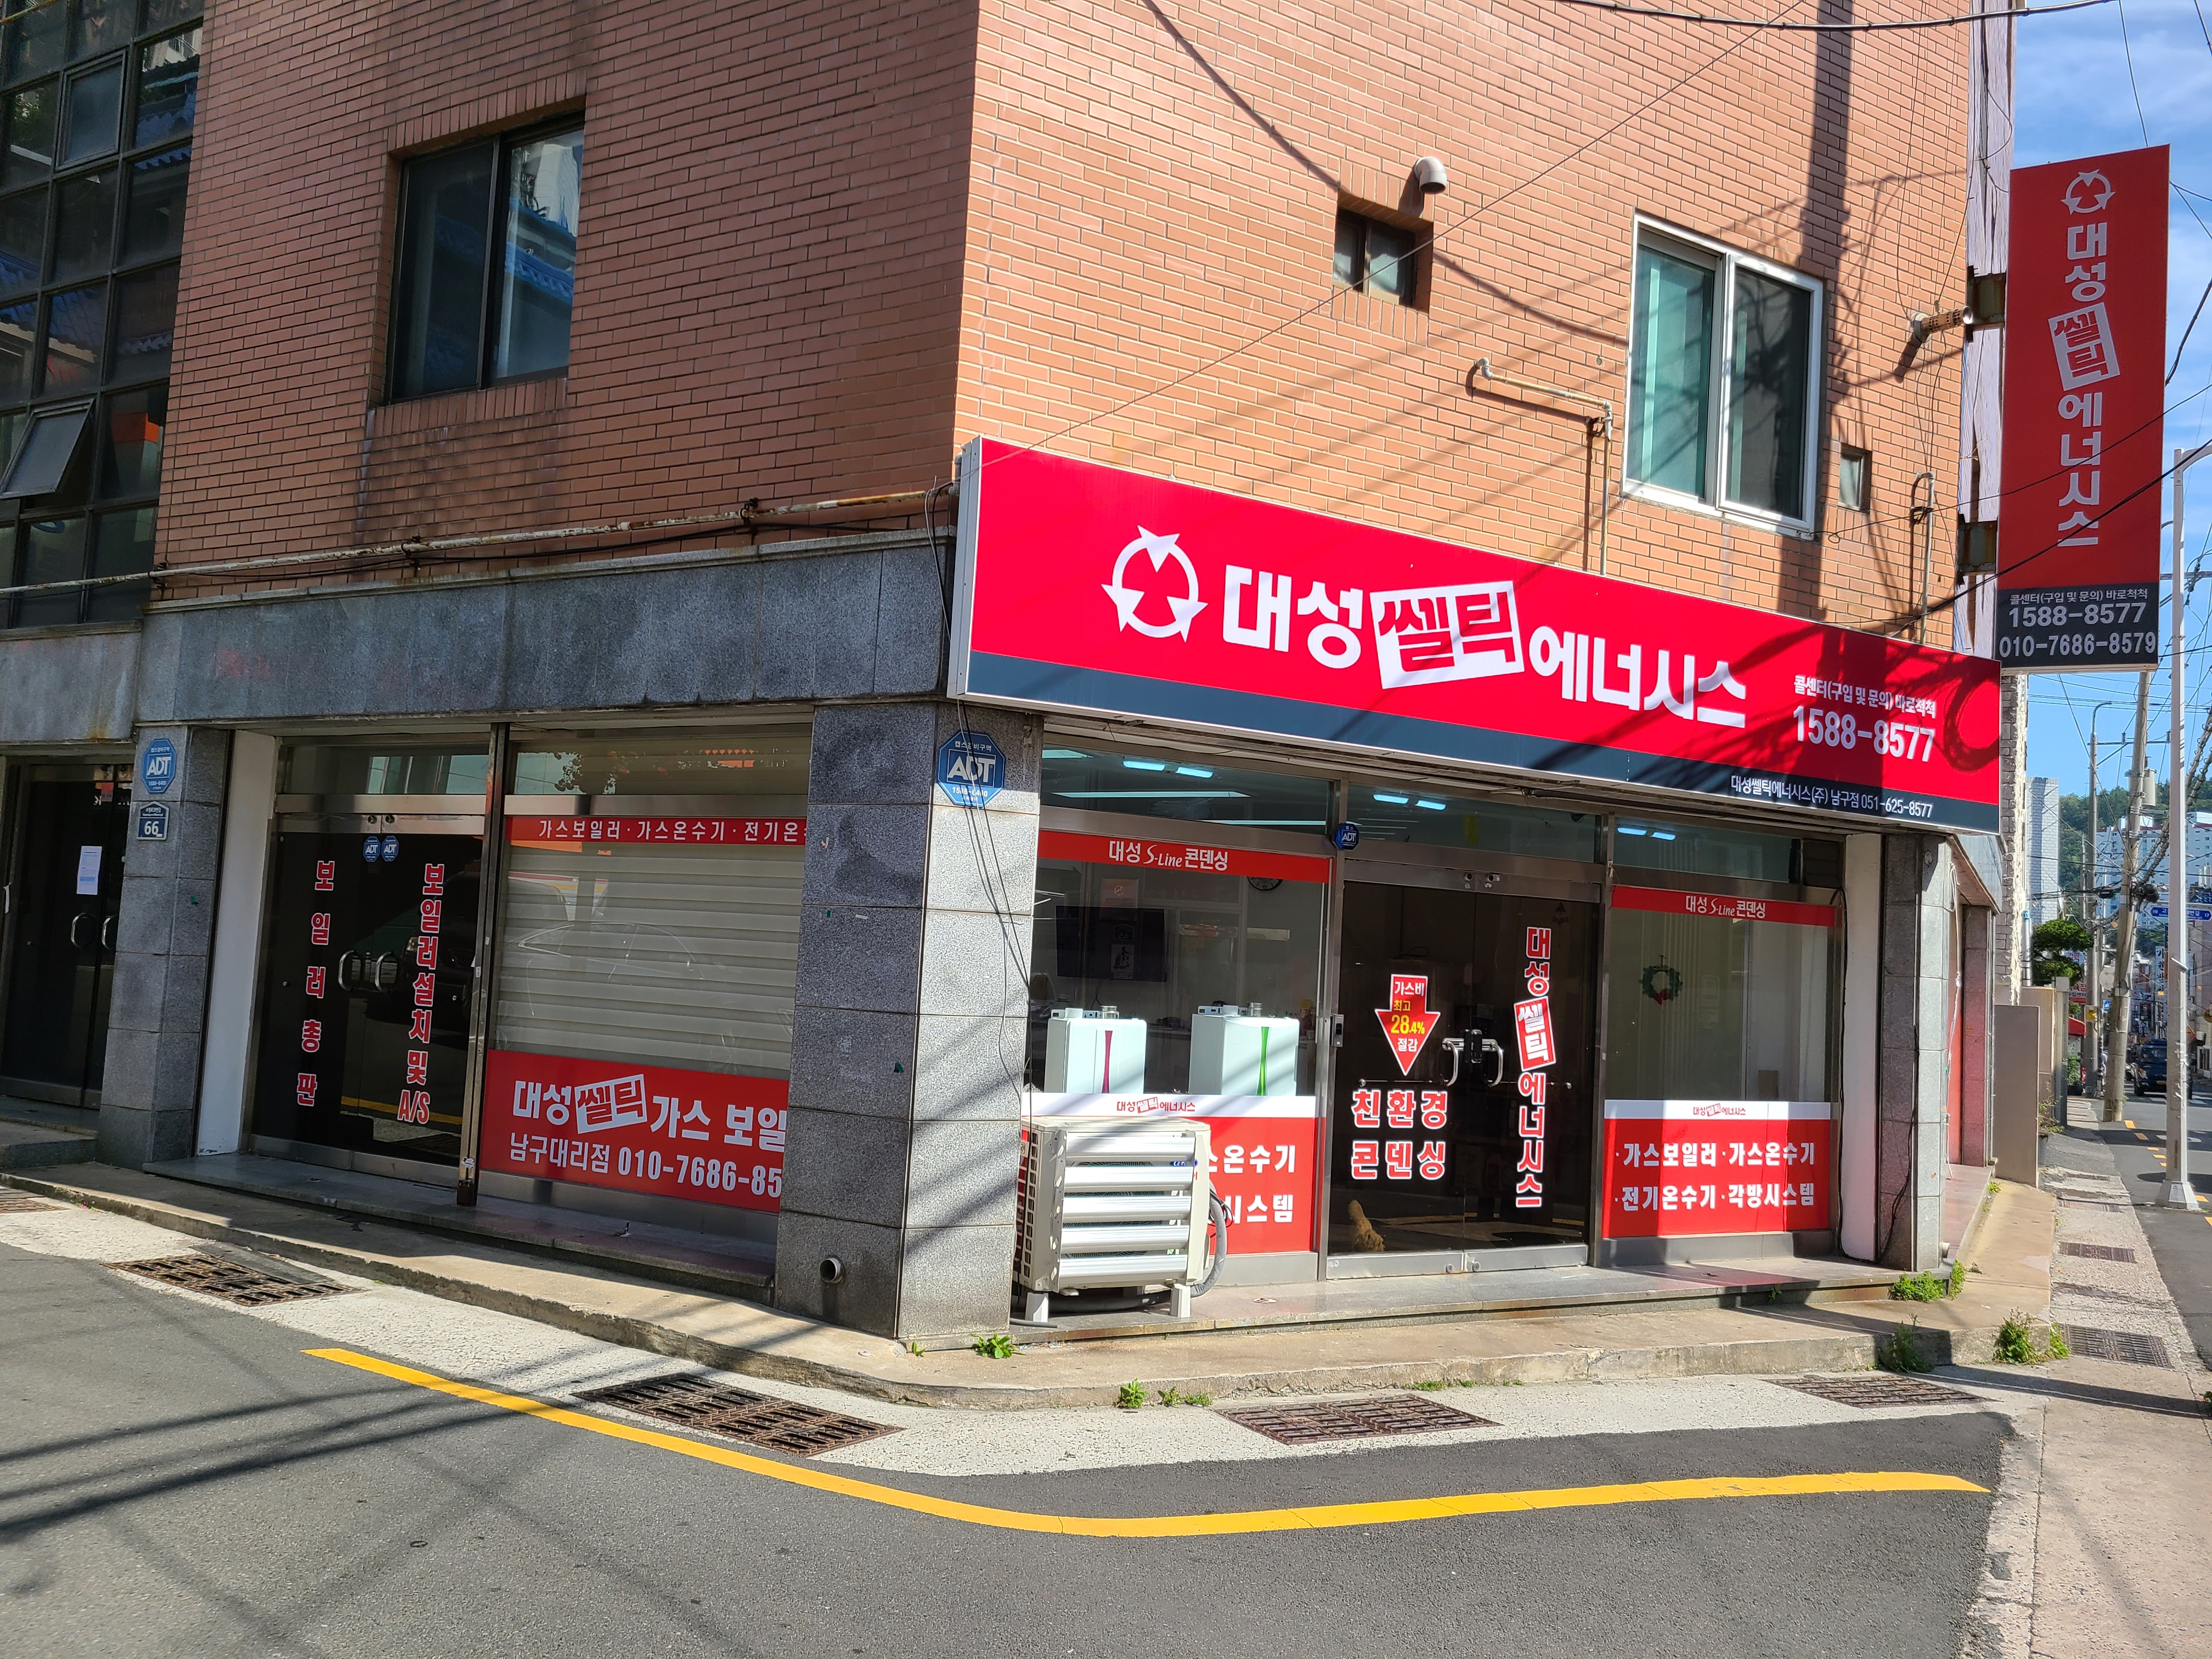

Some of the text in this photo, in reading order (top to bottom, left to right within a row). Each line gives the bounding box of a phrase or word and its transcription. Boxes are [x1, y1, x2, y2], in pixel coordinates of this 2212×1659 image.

[2067, 591, 2076, 603] 및
[2078, 590, 2103, 603] 문의)
[2009, 602, 2146, 628] 1588-8577
[1999, 632, 2155, 658] 010-7686-8579
[1855, 687, 1865, 706] 및
[1868, 689, 1893, 710] 문의)
[1793, 706, 1935, 763] 1588-8577
[146, 757, 171, 776] ADT
[947, 755, 995, 783] ADT
[1831, 790, 1859, 809] 남구점
[1861, 794, 1933, 818] 051-625-8577
[144, 821, 159, 835] 66
[1341, 832, 1356, 842] ADT
[365, 844, 379, 854] ADT
[383, 844, 397, 854] ADT
[1108, 840, 1141, 864] 대성
[1184, 848, 1228, 871] 콘덴싱
[1685, 895, 1707, 914] 대성
[1736, 900, 1766, 919] 콘덴싱
[1394, 981, 1425, 996] 가스비
[1393, 1000, 1410, 1011] 최고
[1391, 1014, 1425, 1034] 28.4%
[1397, 1038, 1418, 1052] 절감
[407, 1050, 428, 1086] 및
[397, 1090, 430, 1125] A/S
[1351, 1089, 1448, 1129] 친환경
[510, 1132, 610, 1173] 남구대리점
[1351, 1140, 1446, 1180] 콘덴싱
